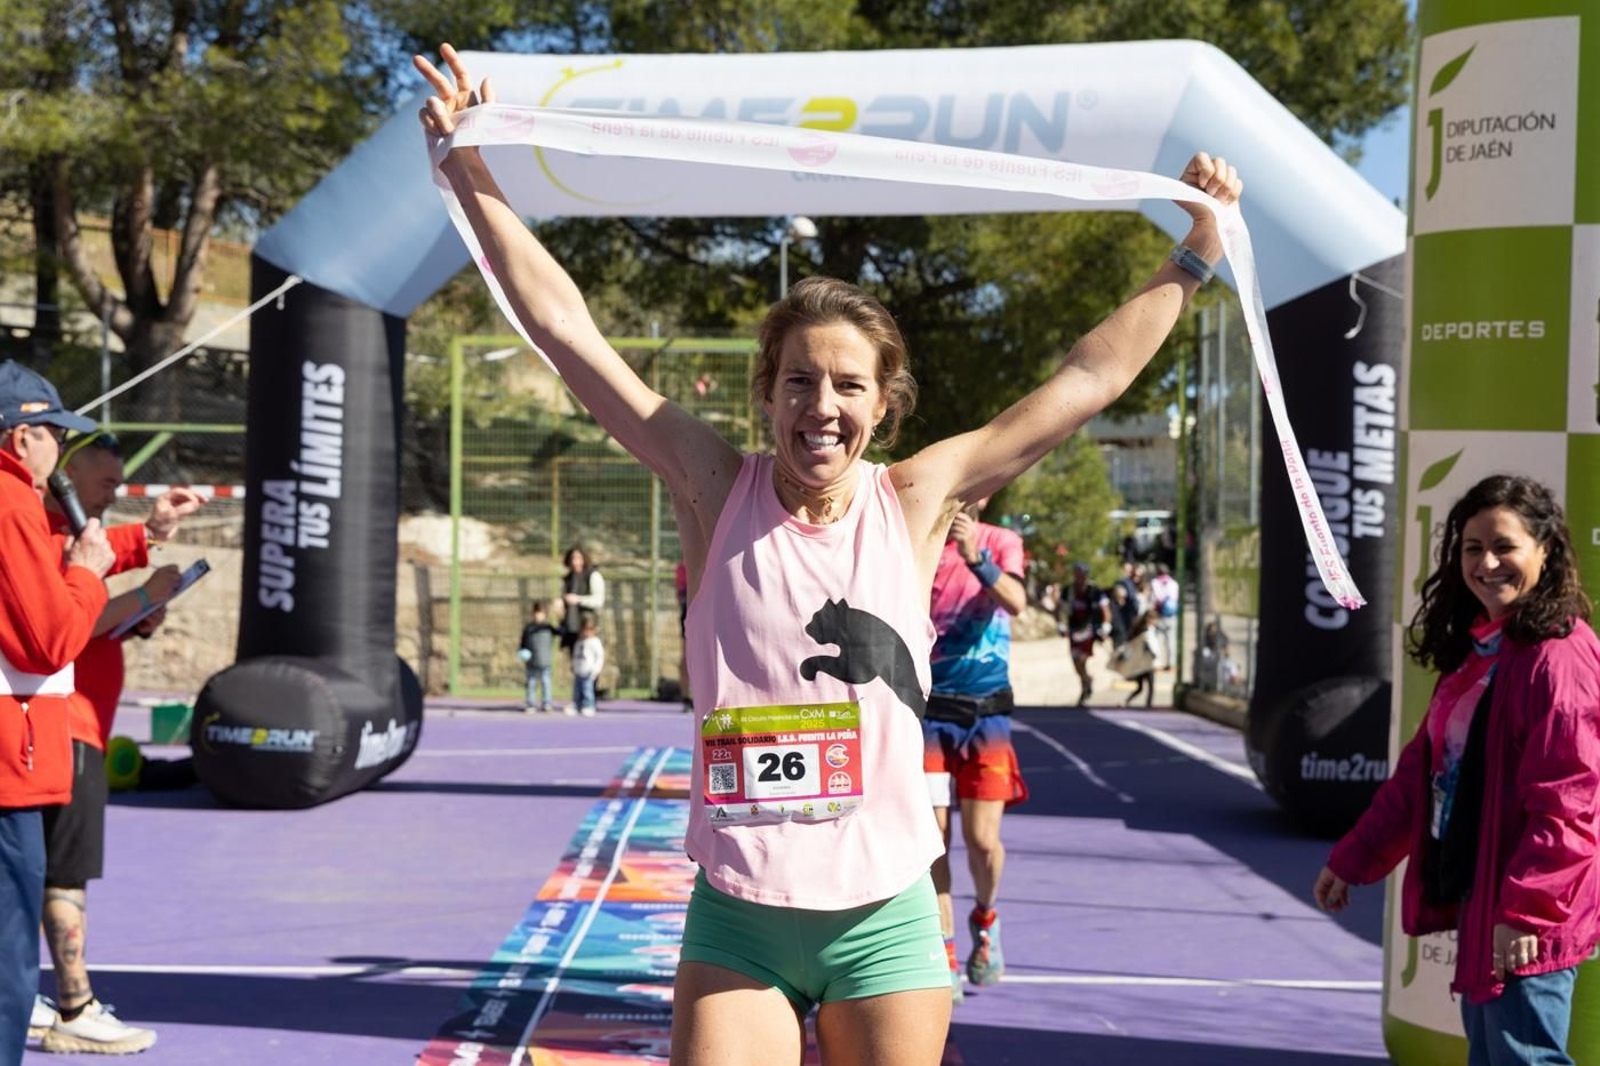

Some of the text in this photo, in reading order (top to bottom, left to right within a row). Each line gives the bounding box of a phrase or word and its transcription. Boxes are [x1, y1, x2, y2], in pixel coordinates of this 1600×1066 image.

[1446, 111, 1556, 139] DIPUTACIÓN
[1446, 139, 1512, 163] DE JAÉN
[1422, 320, 1545, 341] DEPORTES
[290, 360, 346, 549] TUS LÍMITES
[1353, 360, 1396, 539] TUS METAS
[258, 478, 297, 613] SUPERA
[1305, 448, 1350, 631] COGUE
[800, 708, 824, 719] CxM
[800, 719, 824, 729] 2025
[207, 725, 315, 747] TIME2RUN
[738, 735, 776, 745] SOLIDARIO
[798, 732, 825, 742] FUENTE
[826, 731, 836, 740] LA
[757, 751, 806, 782] 26
[1301, 752, 1389, 781] time2ru
[1422, 943, 1441, 963] DE
